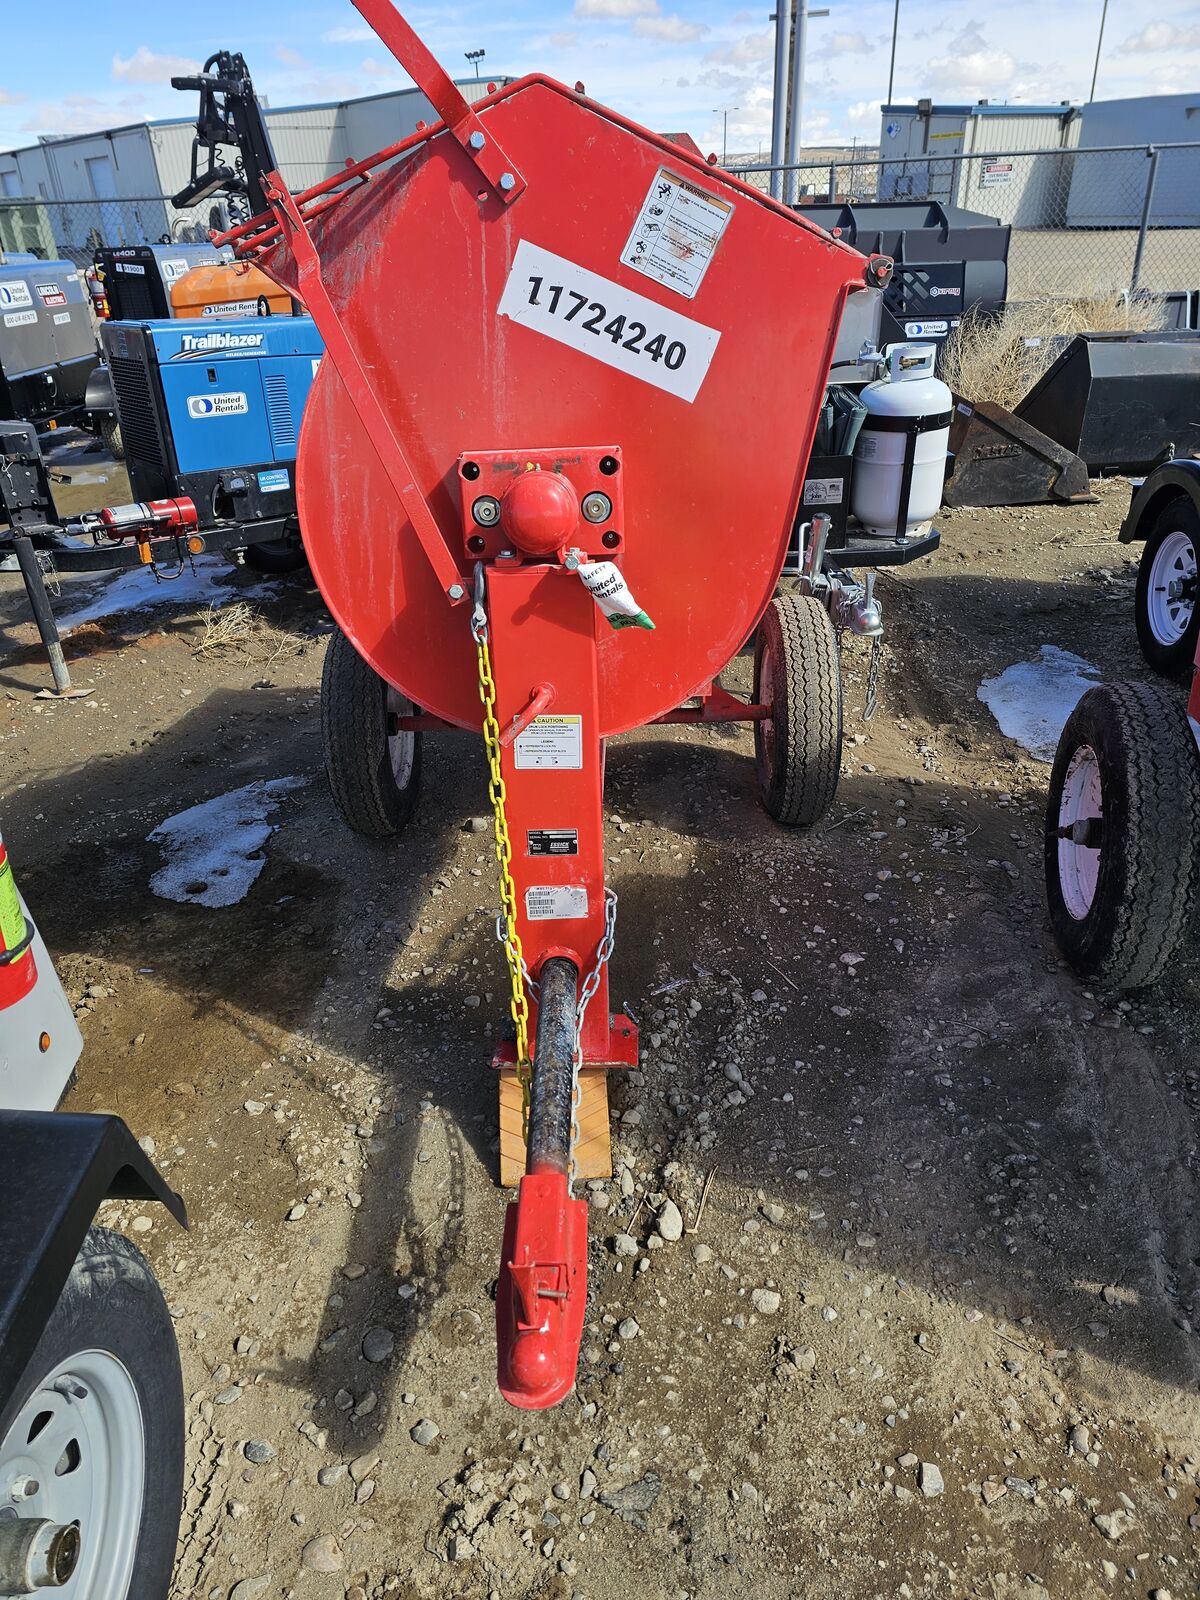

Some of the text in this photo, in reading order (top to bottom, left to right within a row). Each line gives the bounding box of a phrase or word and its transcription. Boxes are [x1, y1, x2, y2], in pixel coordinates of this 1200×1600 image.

[684, 183, 710, 201] WARNING
[213, 304, 237, 313] United
[528, 276, 687, 371] 11724240
[181, 332, 264, 351] Trailblazer
[213, 395, 241, 405] United
[215, 403, 245, 413] Rentals
